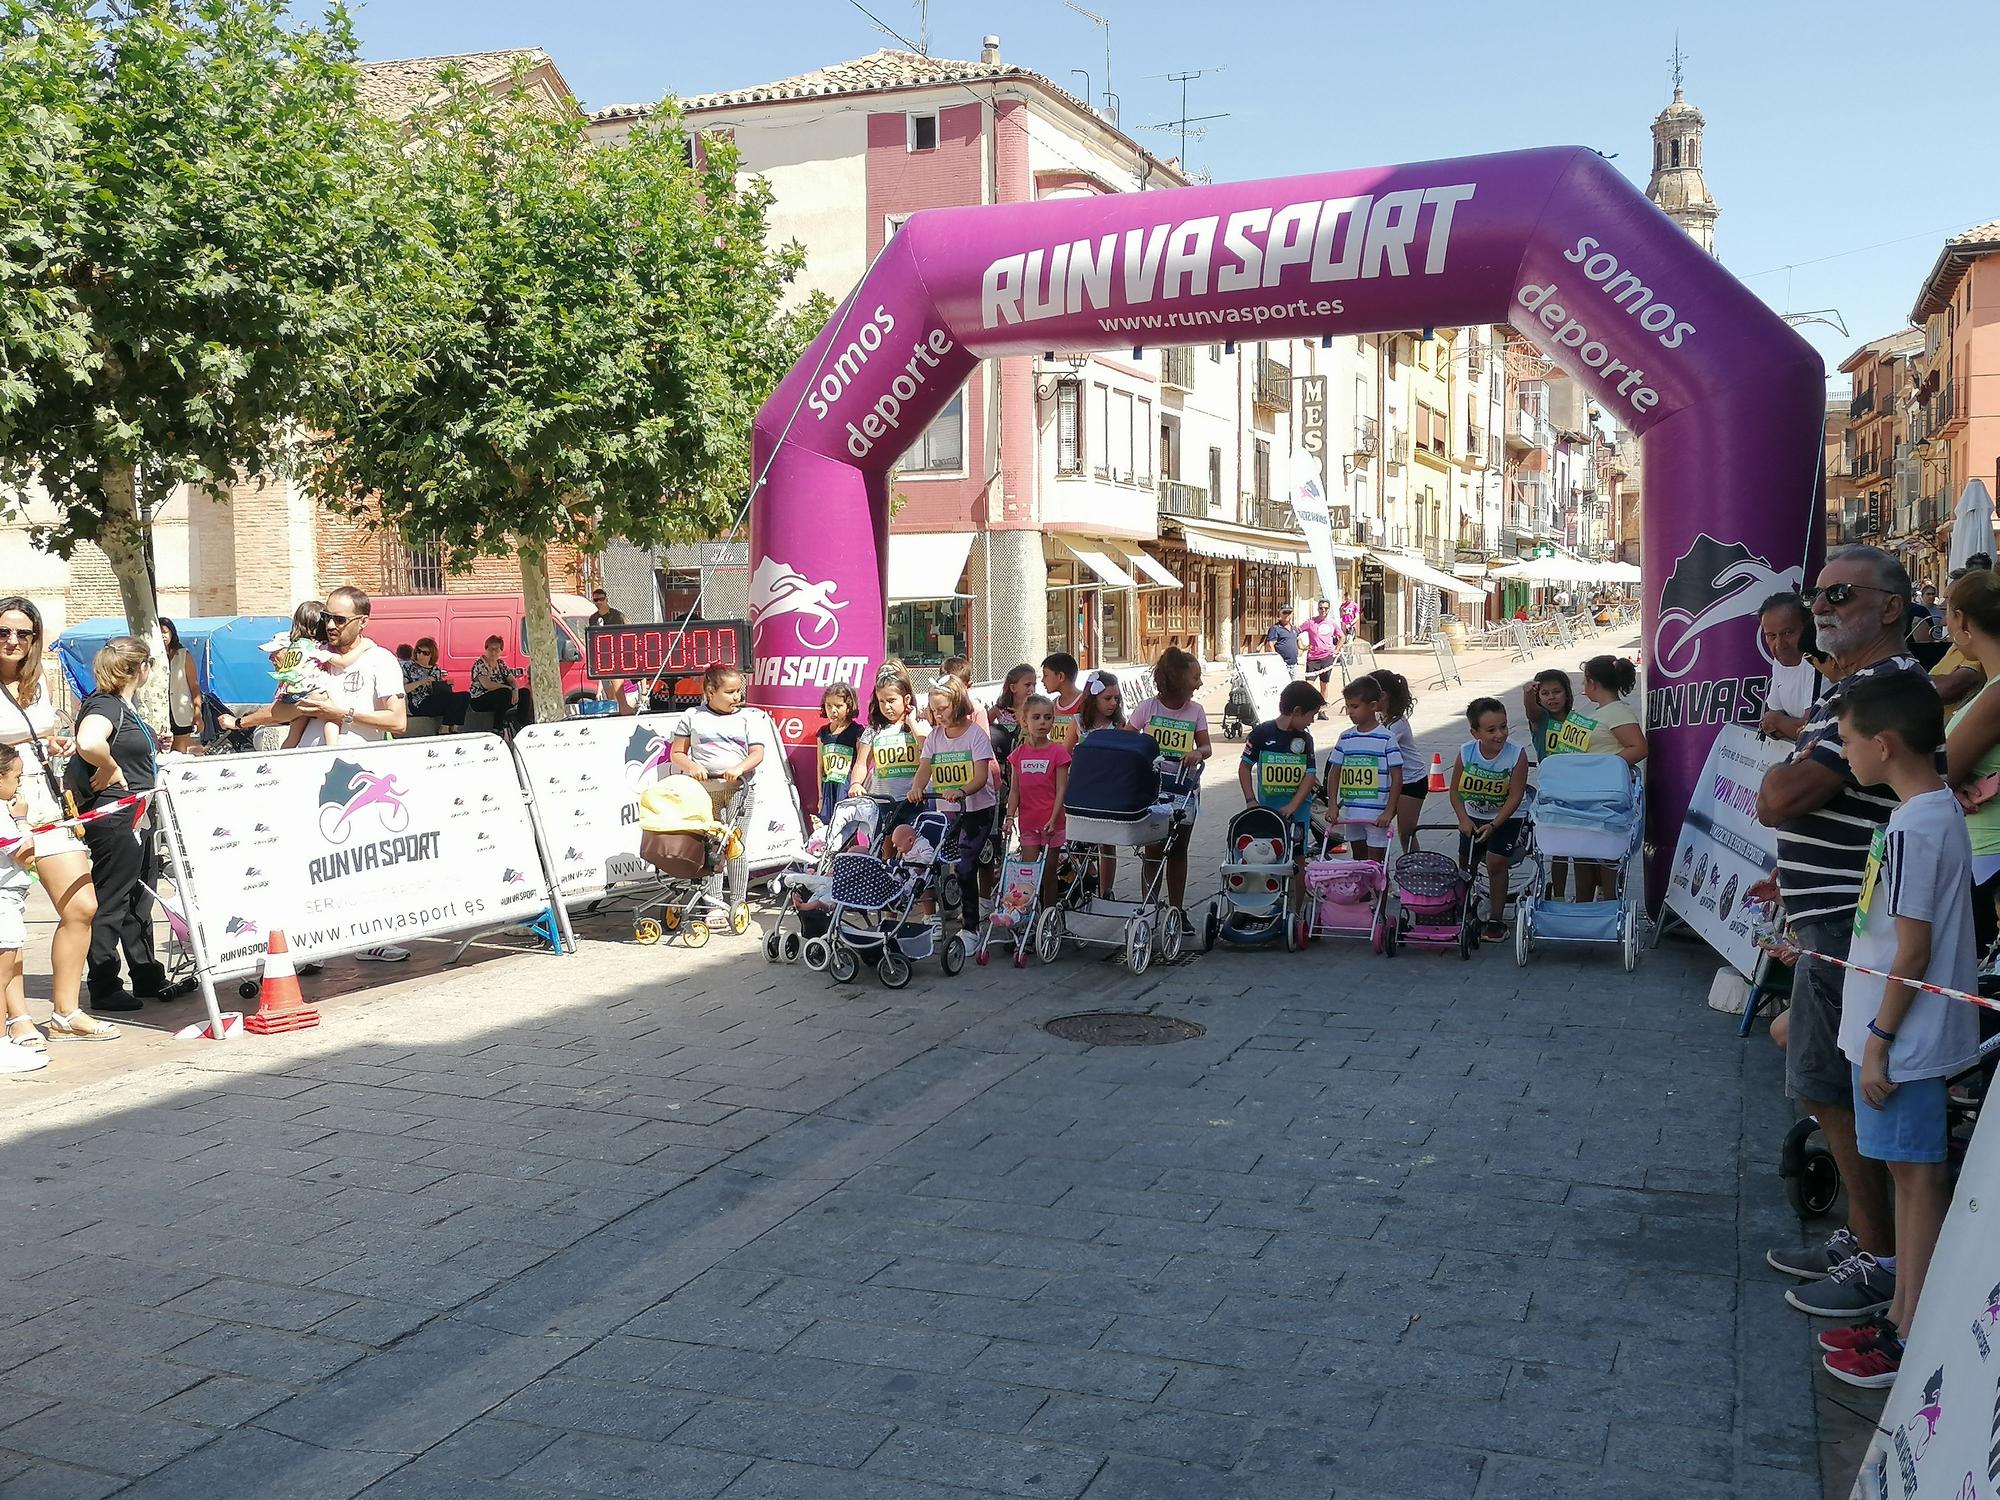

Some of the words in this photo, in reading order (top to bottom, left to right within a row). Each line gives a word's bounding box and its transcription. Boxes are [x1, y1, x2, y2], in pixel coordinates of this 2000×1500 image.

[1562, 235, 1697, 350] somos
[1098, 296, 1345, 333] www.runvasport.es
[1516, 281, 1664, 416] deporte
[808, 301, 896, 421] somos
[844, 326, 954, 460] deporte
[1154, 728, 1187, 749] 0031
[1562, 724, 1588, 747] 0017
[878, 746, 915, 765] 0020
[936, 764, 968, 784] 0001
[1266, 766, 1302, 784] 0009
[1341, 768, 1373, 785] 0049
[1463, 776, 1504, 794] 0045
